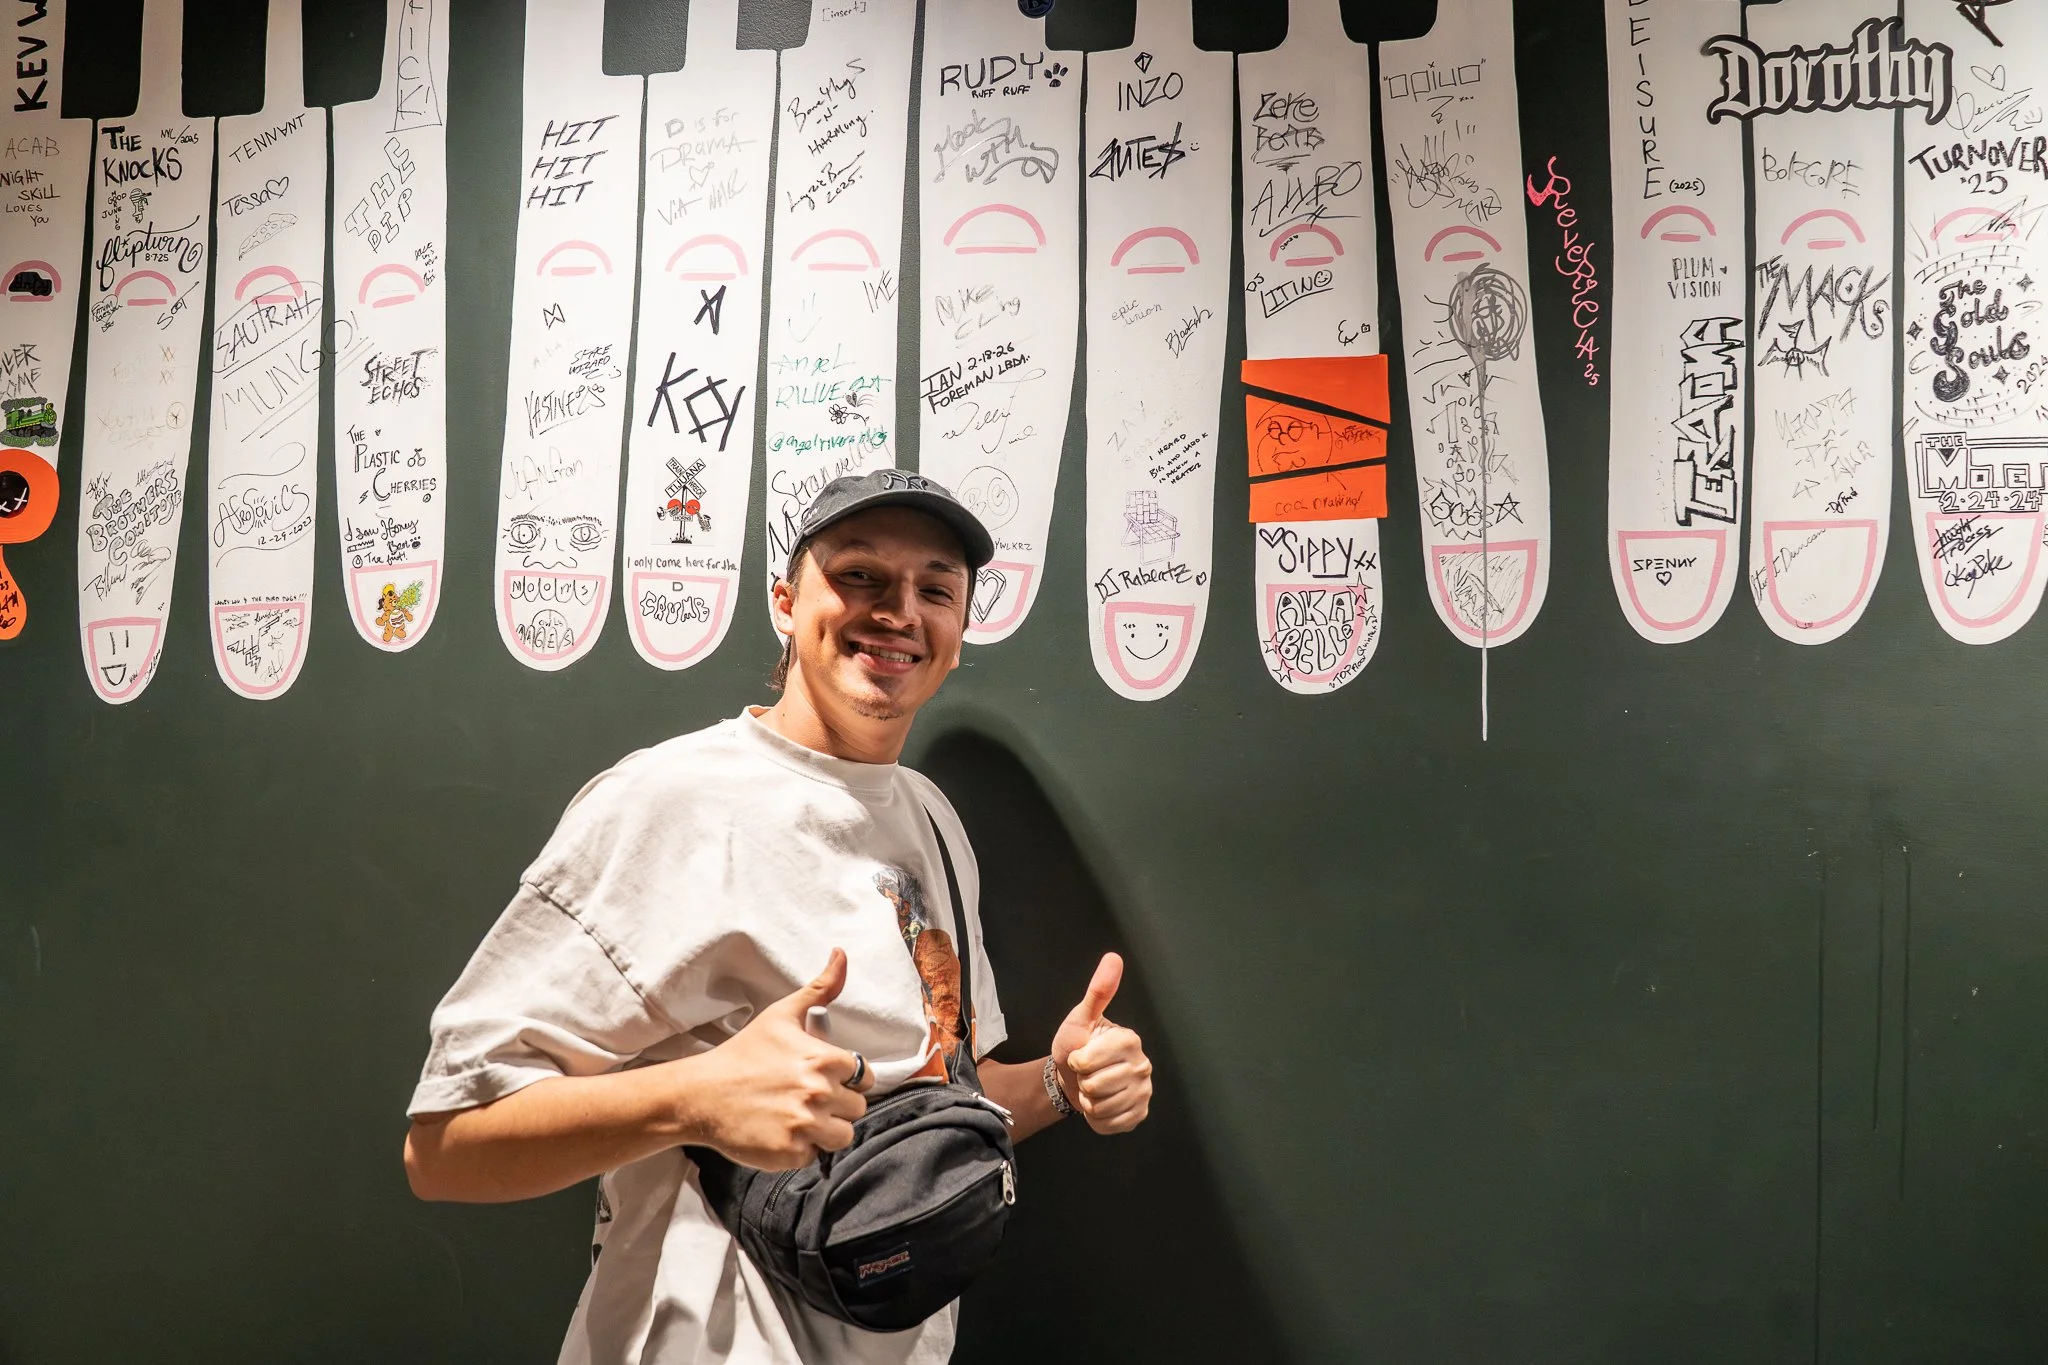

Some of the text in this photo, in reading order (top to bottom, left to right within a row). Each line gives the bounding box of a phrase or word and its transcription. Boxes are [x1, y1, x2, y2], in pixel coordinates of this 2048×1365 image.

[940, 51, 1044, 96] RUDY
[1701, 16, 1953, 125] Dorothy
[972, 85, 1031, 98] RUFF RUFF
[1118, 72, 1183, 111] INZO
[1628, 0, 1664, 199] EISURE
[5, 136, 60, 159] ACAB
[101, 126, 142, 151] THE
[541, 114, 620, 150] HIT
[102, 147, 183, 187] KNOCKS
[530, 150, 609, 179] HIT
[1908, 136, 2048, 181] TURNOVER
[5, 203, 43, 213] LOVES
[526, 180, 594, 209] HIT
[96, 215, 204, 292] flipturn
[1671, 257, 1715, 280] PLUM
[1667, 280, 1722, 299] VISION
[359, 349, 437, 387] STREET
[921, 342, 1015, 397] IAN 2-18-26
[367, 378, 424, 405] ECHOS
[928, 367, 994, 414] FOREMAN
[347, 425, 366, 444] THE
[1926, 436, 1964, 447] THE
[354, 443, 400, 473] PLASTIC
[372, 467, 437, 500] CHERRIES
[667, 461, 705, 494] TIJUANA
[627, 559, 630, 567] I
[634, 558, 653, 571] only
[656, 557, 682, 570] come
[706, 558, 721, 570] for
[1278, 529, 1353, 578] SIPPY
[1633, 557, 1697, 572] SPENNY
[1094, 568, 1121, 604] DJ
